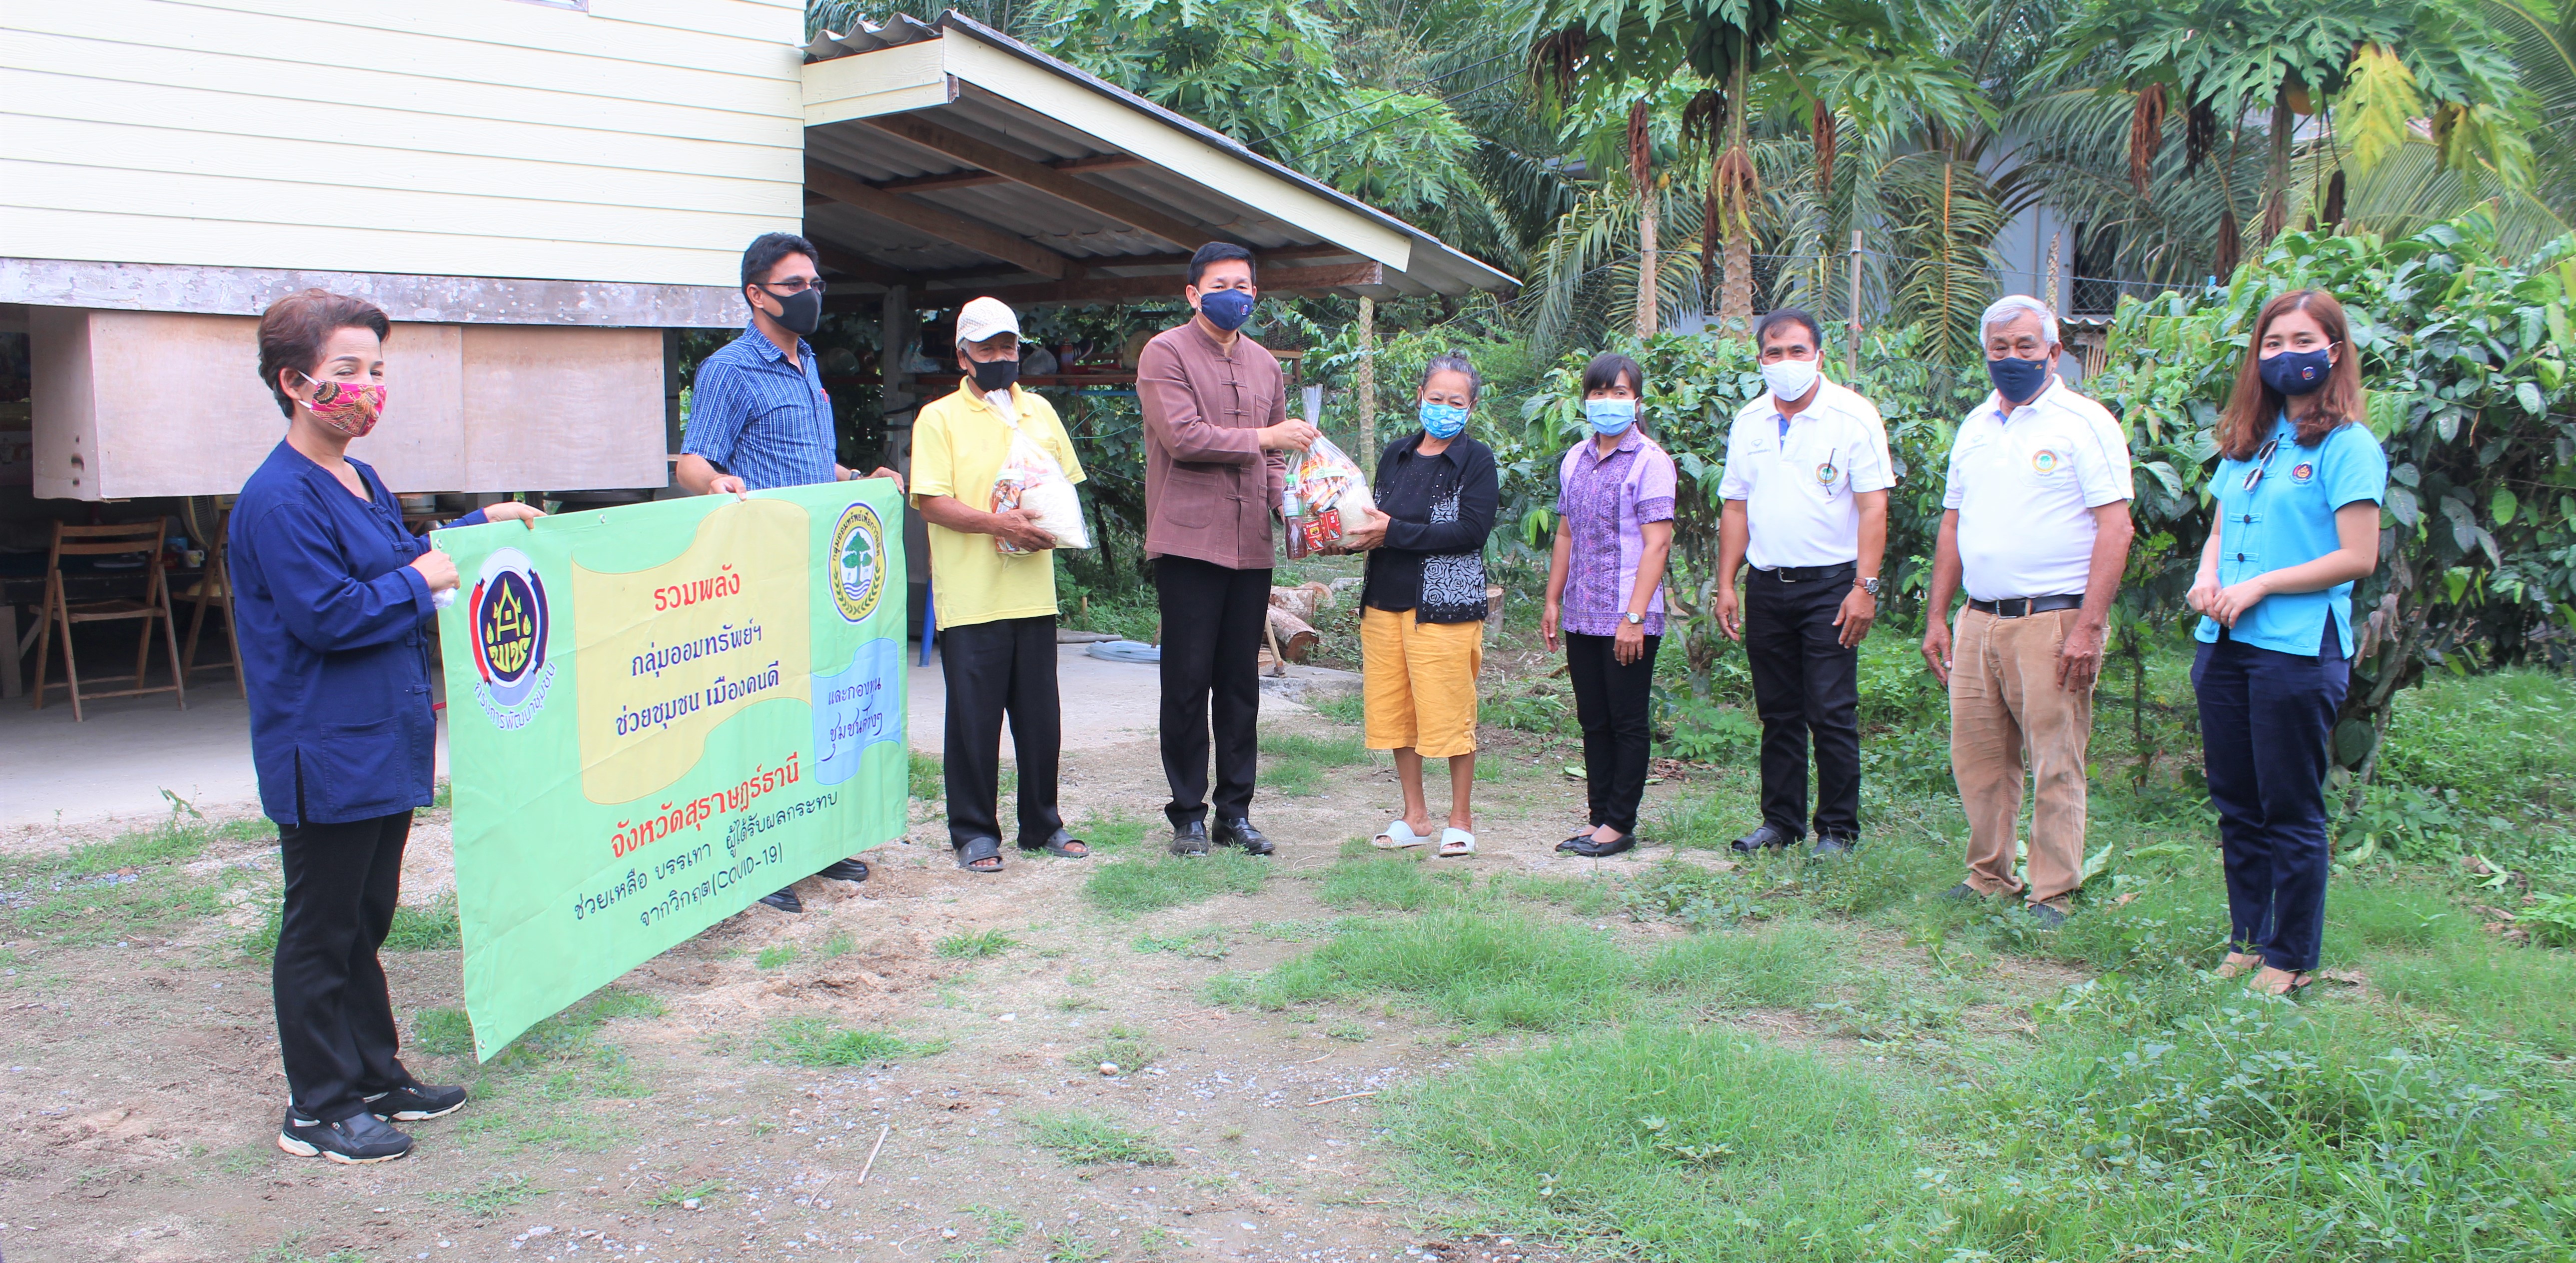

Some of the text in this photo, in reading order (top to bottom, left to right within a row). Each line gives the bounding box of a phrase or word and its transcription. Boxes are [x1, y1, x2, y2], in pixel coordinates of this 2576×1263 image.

[654, 563, 741, 611] รวมพลัง
[632, 617, 762, 678] กลุ่มออมทรัพย์ฯ
[616, 660, 780, 736] ช่วยชุมชน เมืองคนดี
[828, 677, 881, 712] และกองทุน
[574, 791, 838, 920] ช่วยเหลือ บรรเทา ผู้ได้รับผลกระทบ
